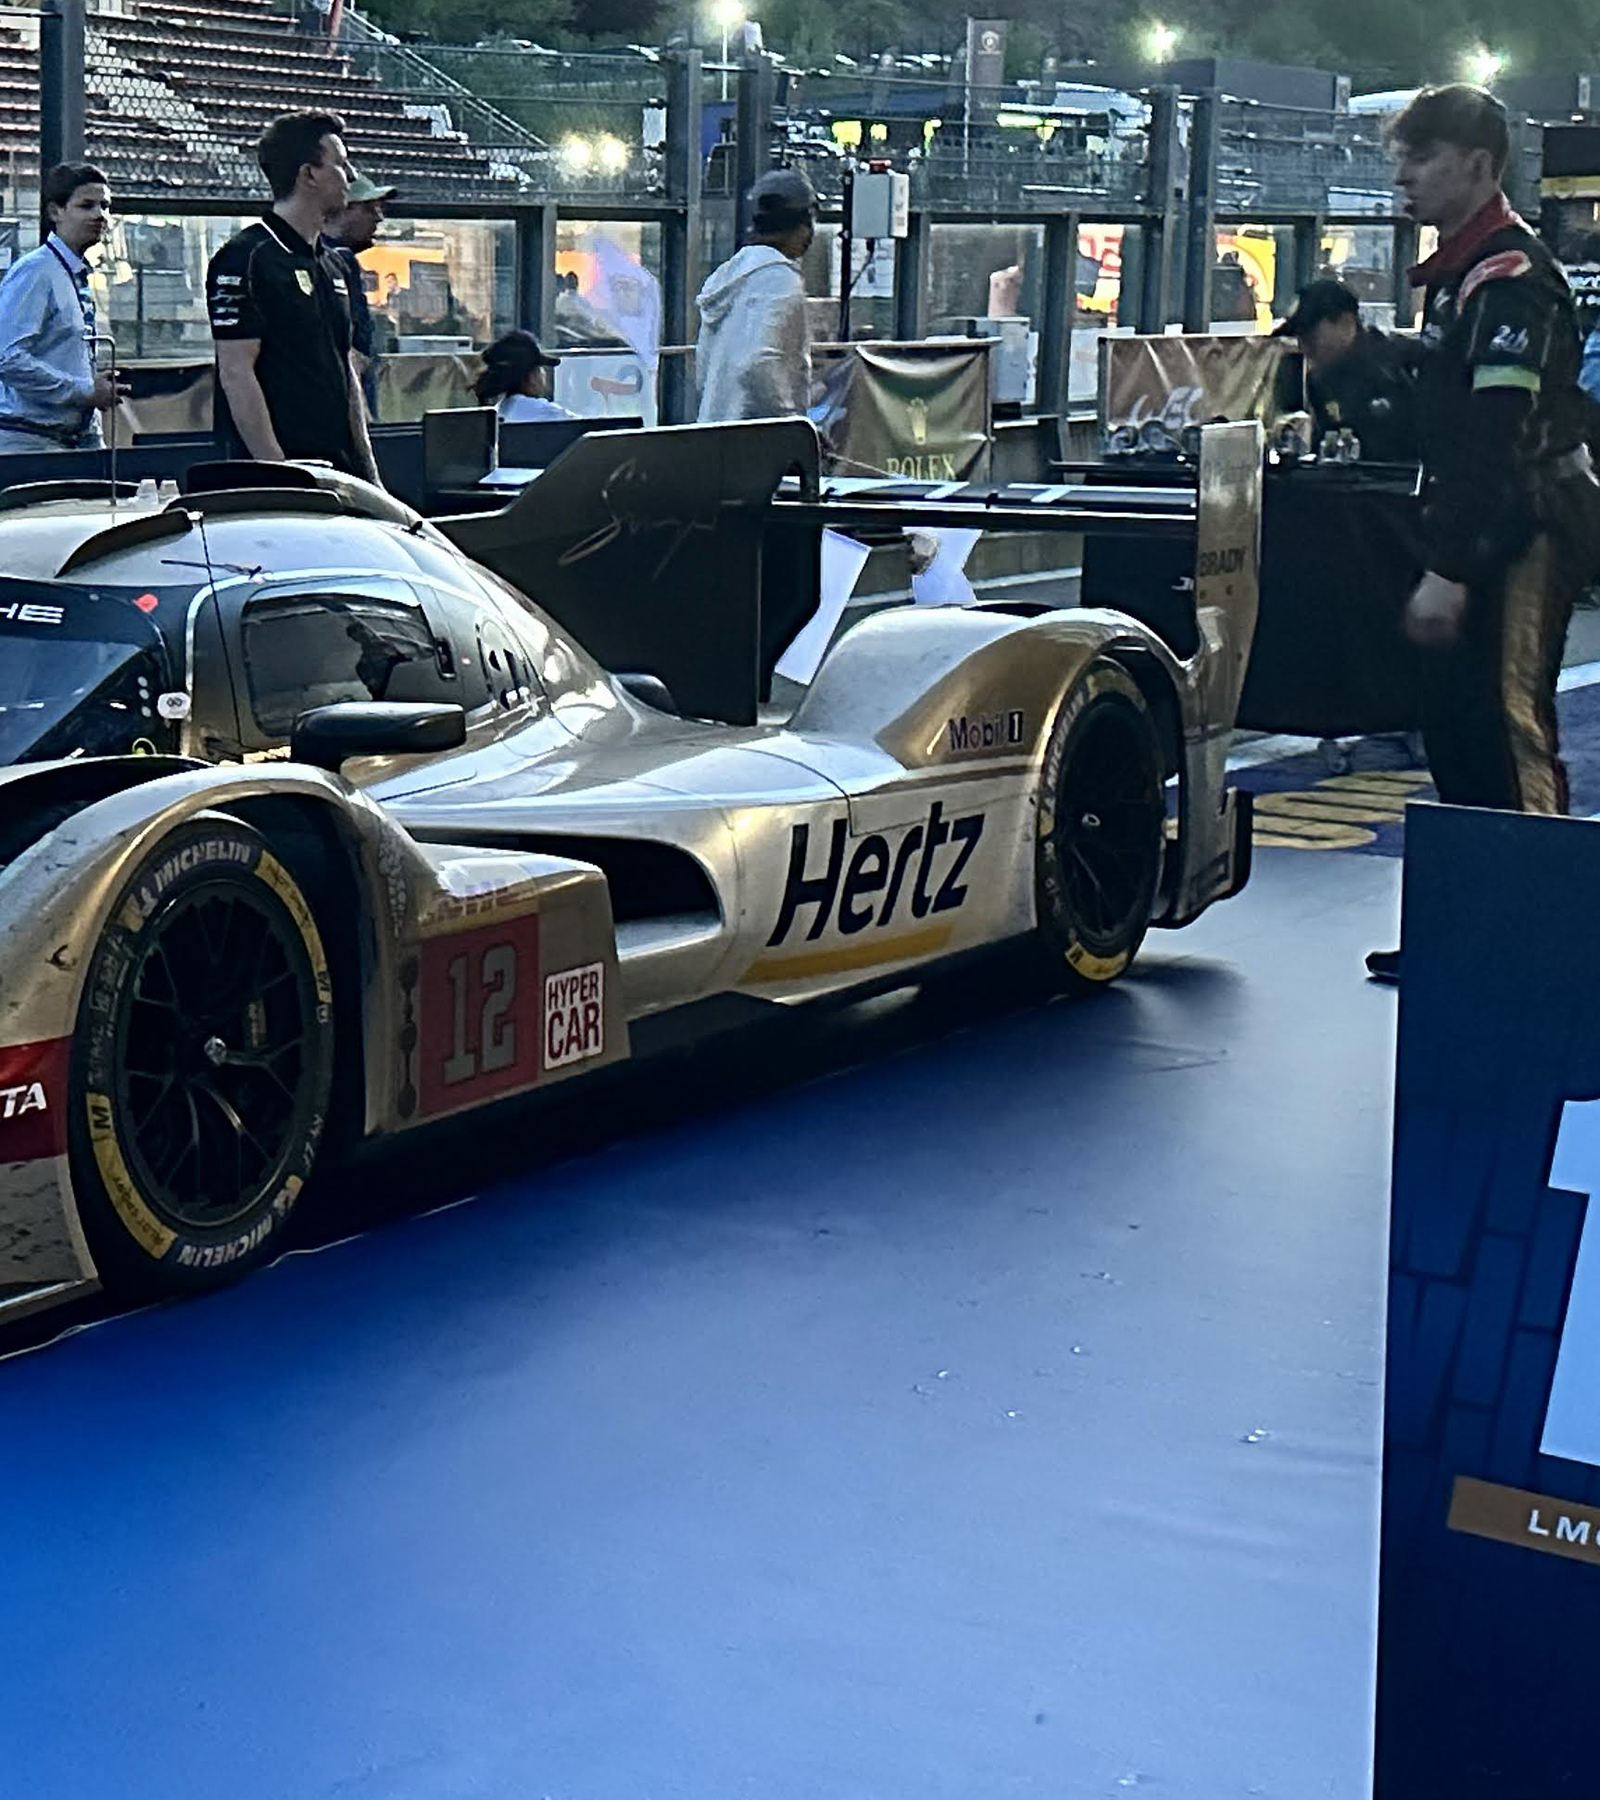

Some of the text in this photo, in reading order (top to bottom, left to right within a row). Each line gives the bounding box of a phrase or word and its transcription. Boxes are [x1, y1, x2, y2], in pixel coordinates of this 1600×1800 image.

[153, 840, 251, 892] MICHELIN
[766, 801, 985, 948] Hertz
[444, 939, 518, 1086] 12
[549, 971, 599, 1010] HYPER
[549, 1002, 599, 1061] CAR
[177, 1214, 273, 1267] MICHELIN
[1527, 1508, 1600, 1548] LM
